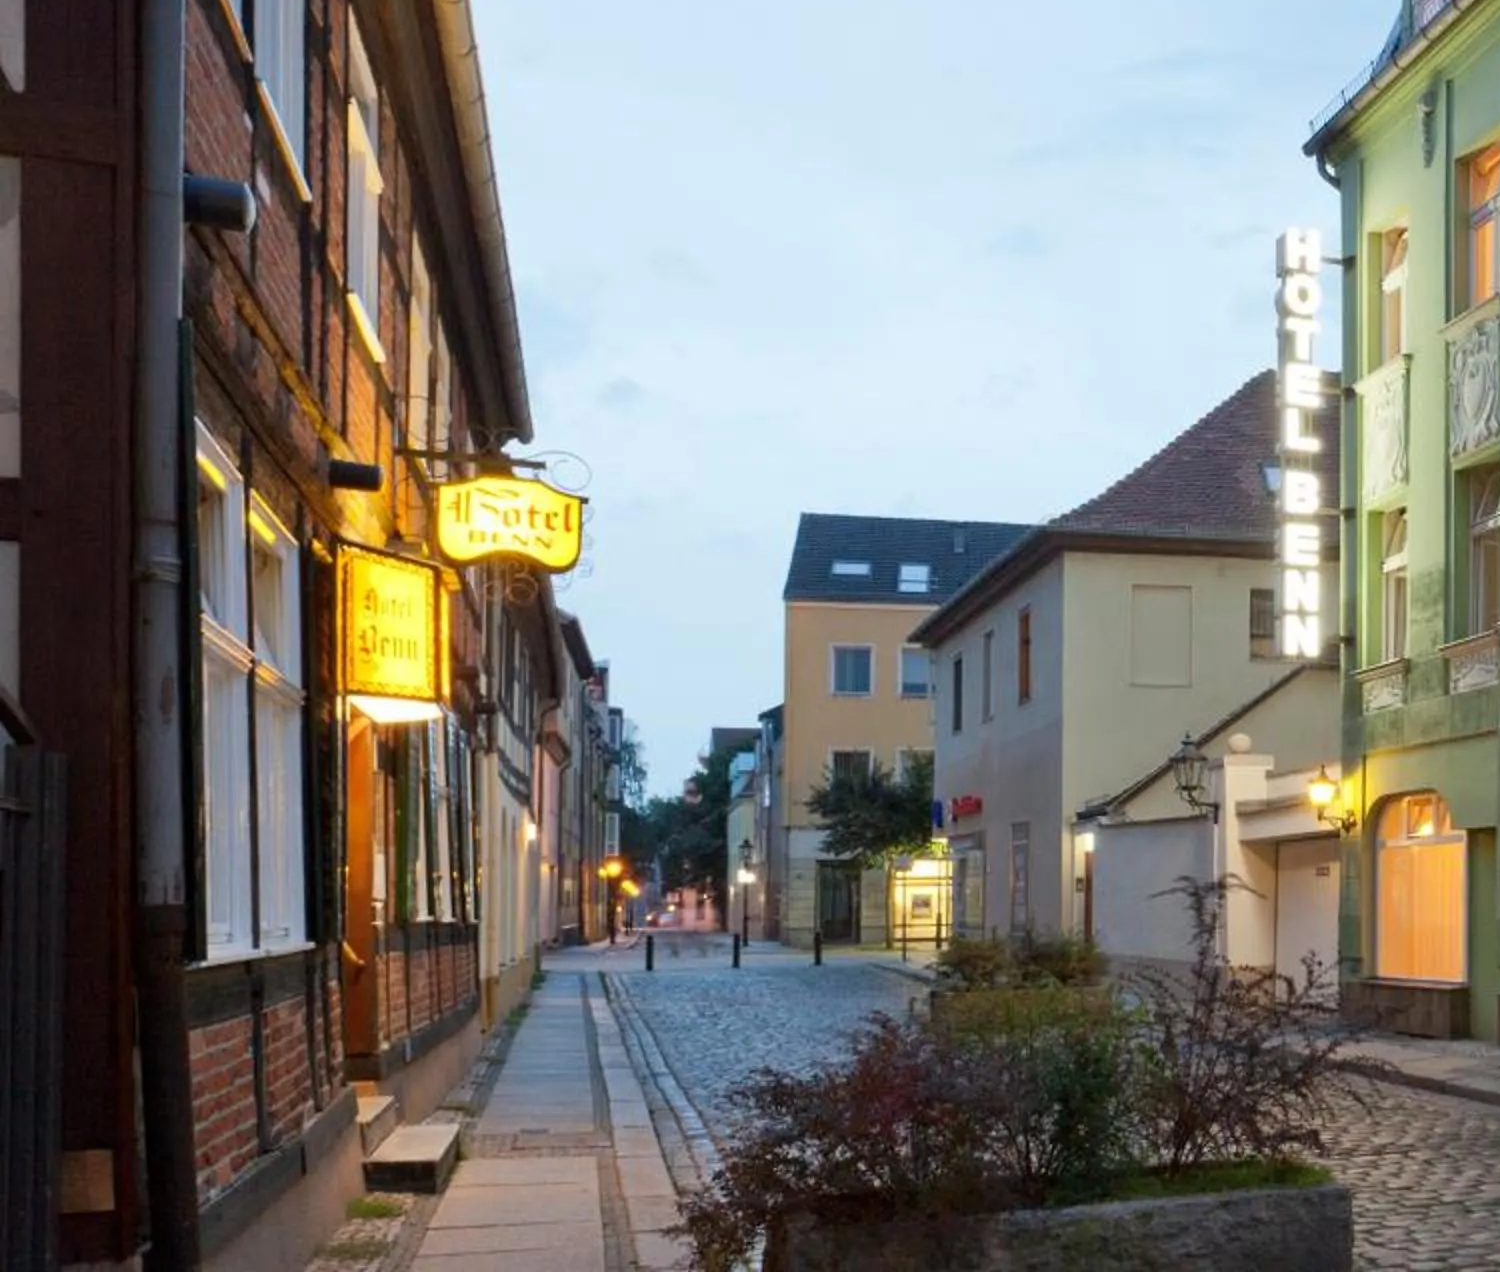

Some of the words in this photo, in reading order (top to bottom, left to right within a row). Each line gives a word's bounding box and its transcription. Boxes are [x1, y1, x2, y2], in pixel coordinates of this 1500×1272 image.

[1281, 226, 1321, 453] HOTEL
[446, 486, 573, 534] Hotel
[1281, 470, 1321, 658] BENN
